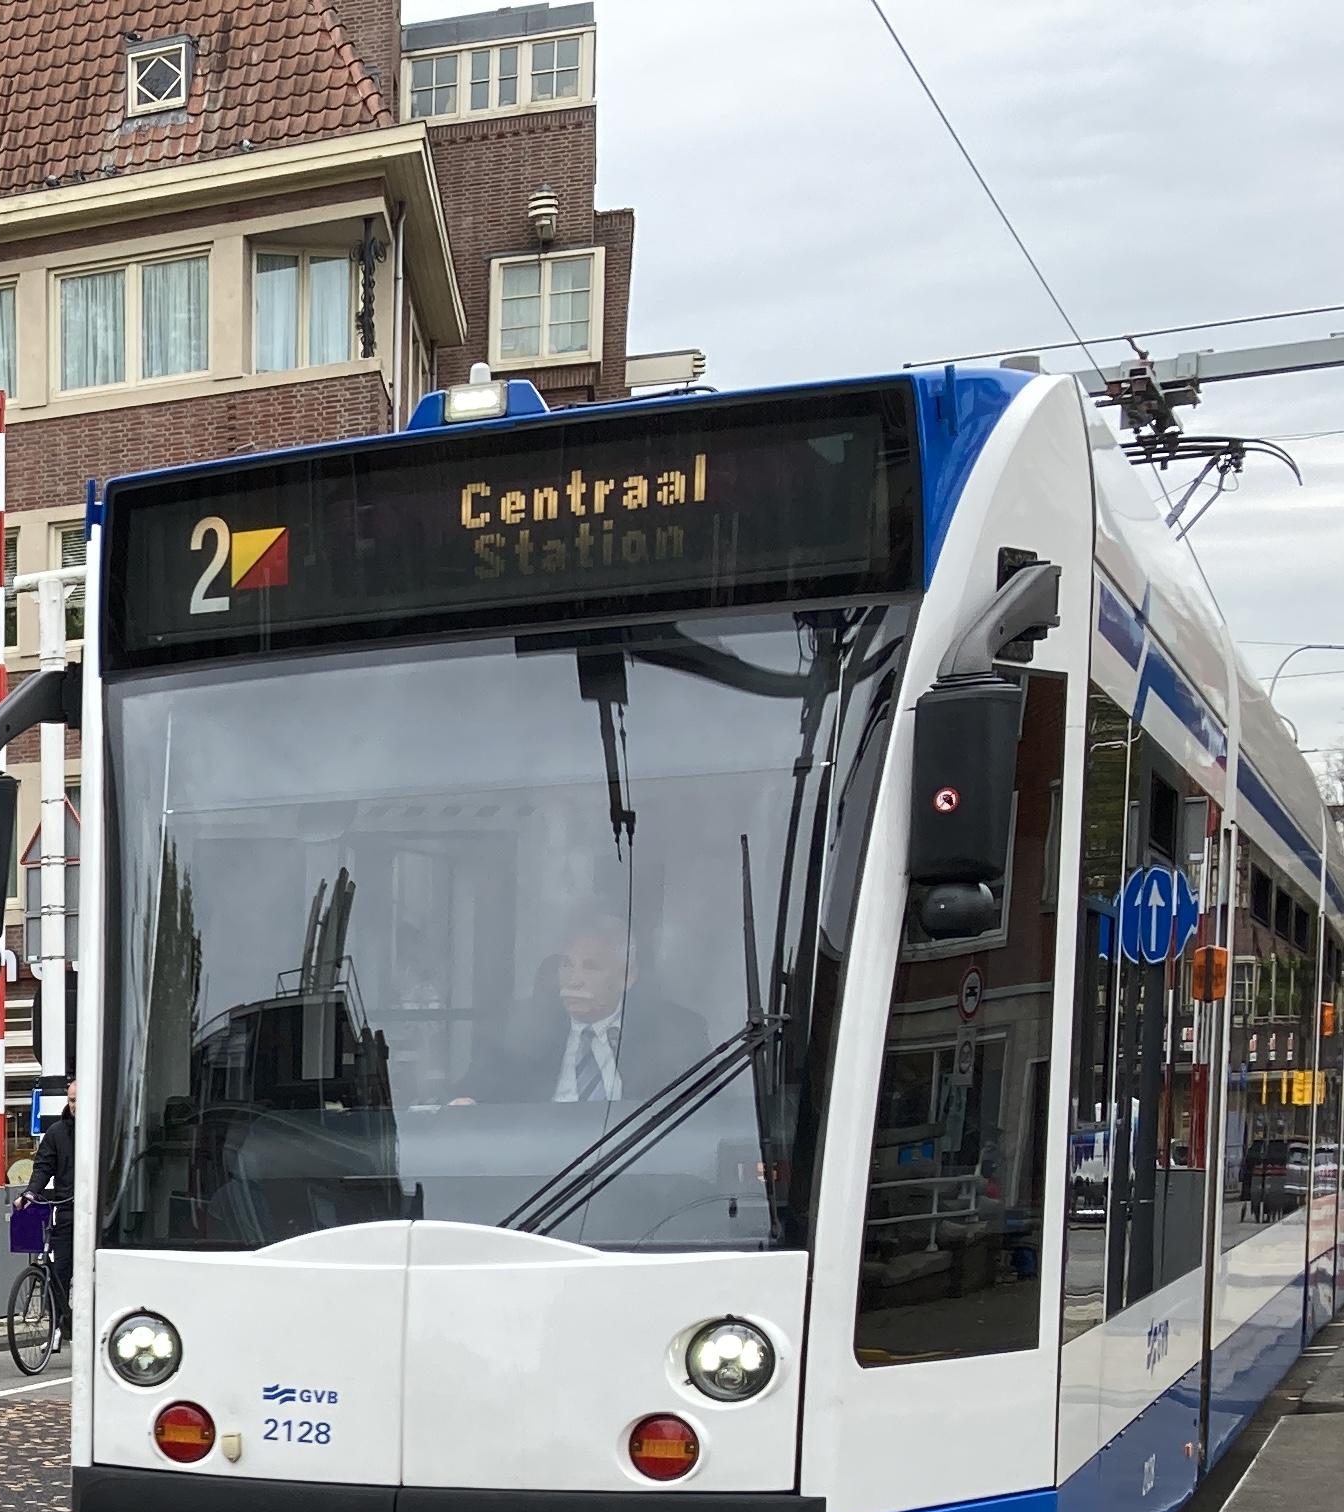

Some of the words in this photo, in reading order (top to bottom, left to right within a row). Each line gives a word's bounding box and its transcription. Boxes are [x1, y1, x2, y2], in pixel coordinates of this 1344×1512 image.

[462, 453, 706, 529] Centraal
[190, 516, 230, 614] 2
[474, 519, 685, 579] Station
[300, 1389, 338, 1404] GVB
[263, 1418, 331, 1445] 2128
